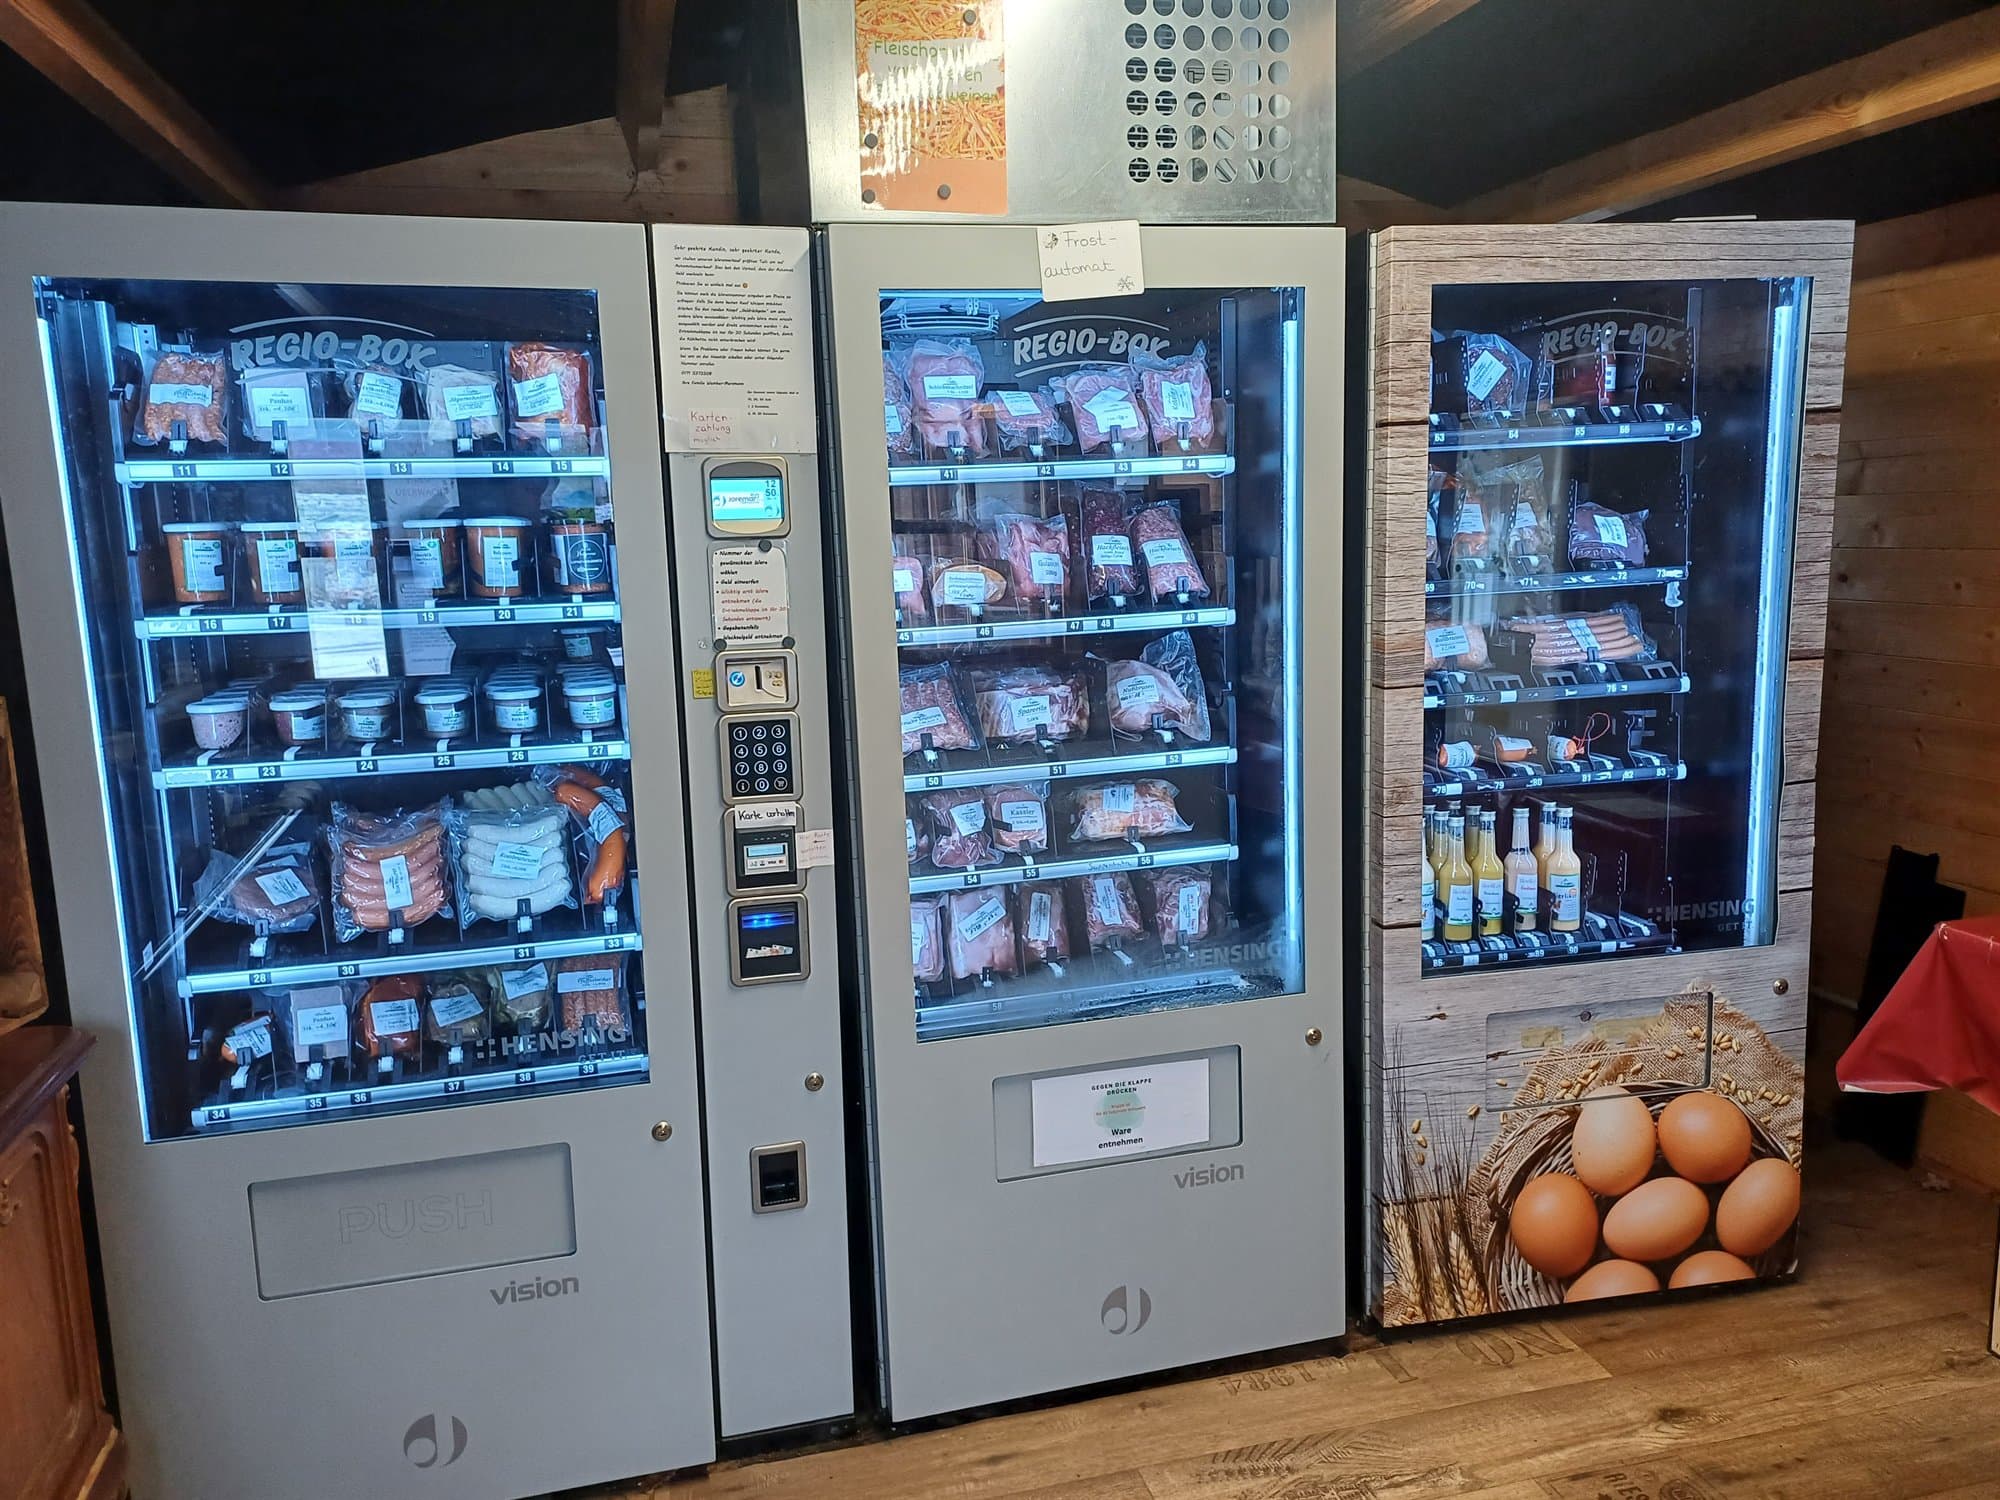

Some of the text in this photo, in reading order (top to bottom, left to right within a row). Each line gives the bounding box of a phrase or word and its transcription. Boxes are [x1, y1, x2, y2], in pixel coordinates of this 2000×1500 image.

[1063, 230, 1117, 248] Frost-
[1044, 260, 1115, 279] automat
[1508, 429, 1519, 440] 64
[1575, 426, 1586, 437] 65
[177, 464, 193, 476] 11
[274, 463, 289, 475] 12
[394, 462, 408, 474] 13
[496, 461, 510, 472] 14
[555, 460, 568, 471] 15
[1040, 466, 1052, 475] 42
[1118, 463, 1129, 472] 43
[943, 471, 954, 479] 41
[765, 479, 776, 488] 12
[765, 488, 777, 497] 50
[422, 612, 435, 622] 19
[498, 609, 511, 620] 20
[566, 607, 578, 617] 21
[203, 619, 217, 630] 16
[272, 616, 285, 627] 17
[1070, 621, 1080, 630] 47
[898, 632, 910, 641] 45
[979, 627, 990, 636] 46
[1464, 694, 1475, 704] 75
[591, 745, 604, 755] 27
[437, 755, 450, 766] 25
[511, 751, 525, 761] 26
[360, 761, 374, 771] 24
[1052, 765, 1063, 775] 51
[214, 769, 229, 779] 22
[262, 767, 276, 777] 23
[928, 777, 939, 786] 50
[738, 810, 763, 820] Karte
[1026, 868, 1036, 878] 55
[967, 875, 978, 884] 54
[1665, 898, 1755, 923] HENSING
[608, 939, 620, 948] 33
[517, 948, 530, 958] 31
[341, 965, 355, 975] 30
[253, 973, 267, 983] 28
[501, 1025, 627, 1057] HENSING
[578, 1049, 626, 1064] GET IT
[582, 1064, 595, 1073] 39
[519, 1072, 532, 1082] 38
[447, 1082, 460, 1091] 37
[1091, 1083, 1113, 1091] GEGEN
[1128, 1078, 1152, 1086] KLAPPE
[1106, 1087, 1137, 1096] DRÜCKEN
[353, 1093, 367, 1102] 36
[309, 1098, 323, 1108] 35
[211, 1110, 225, 1119] 34
[1111, 1127, 1132, 1136] Ware
[1098, 1137, 1144, 1149] entnehmen
[1173, 1163, 1245, 1191] vision
[338, 1188, 494, 1245] PUSH
[489, 1276, 580, 1306] vision
